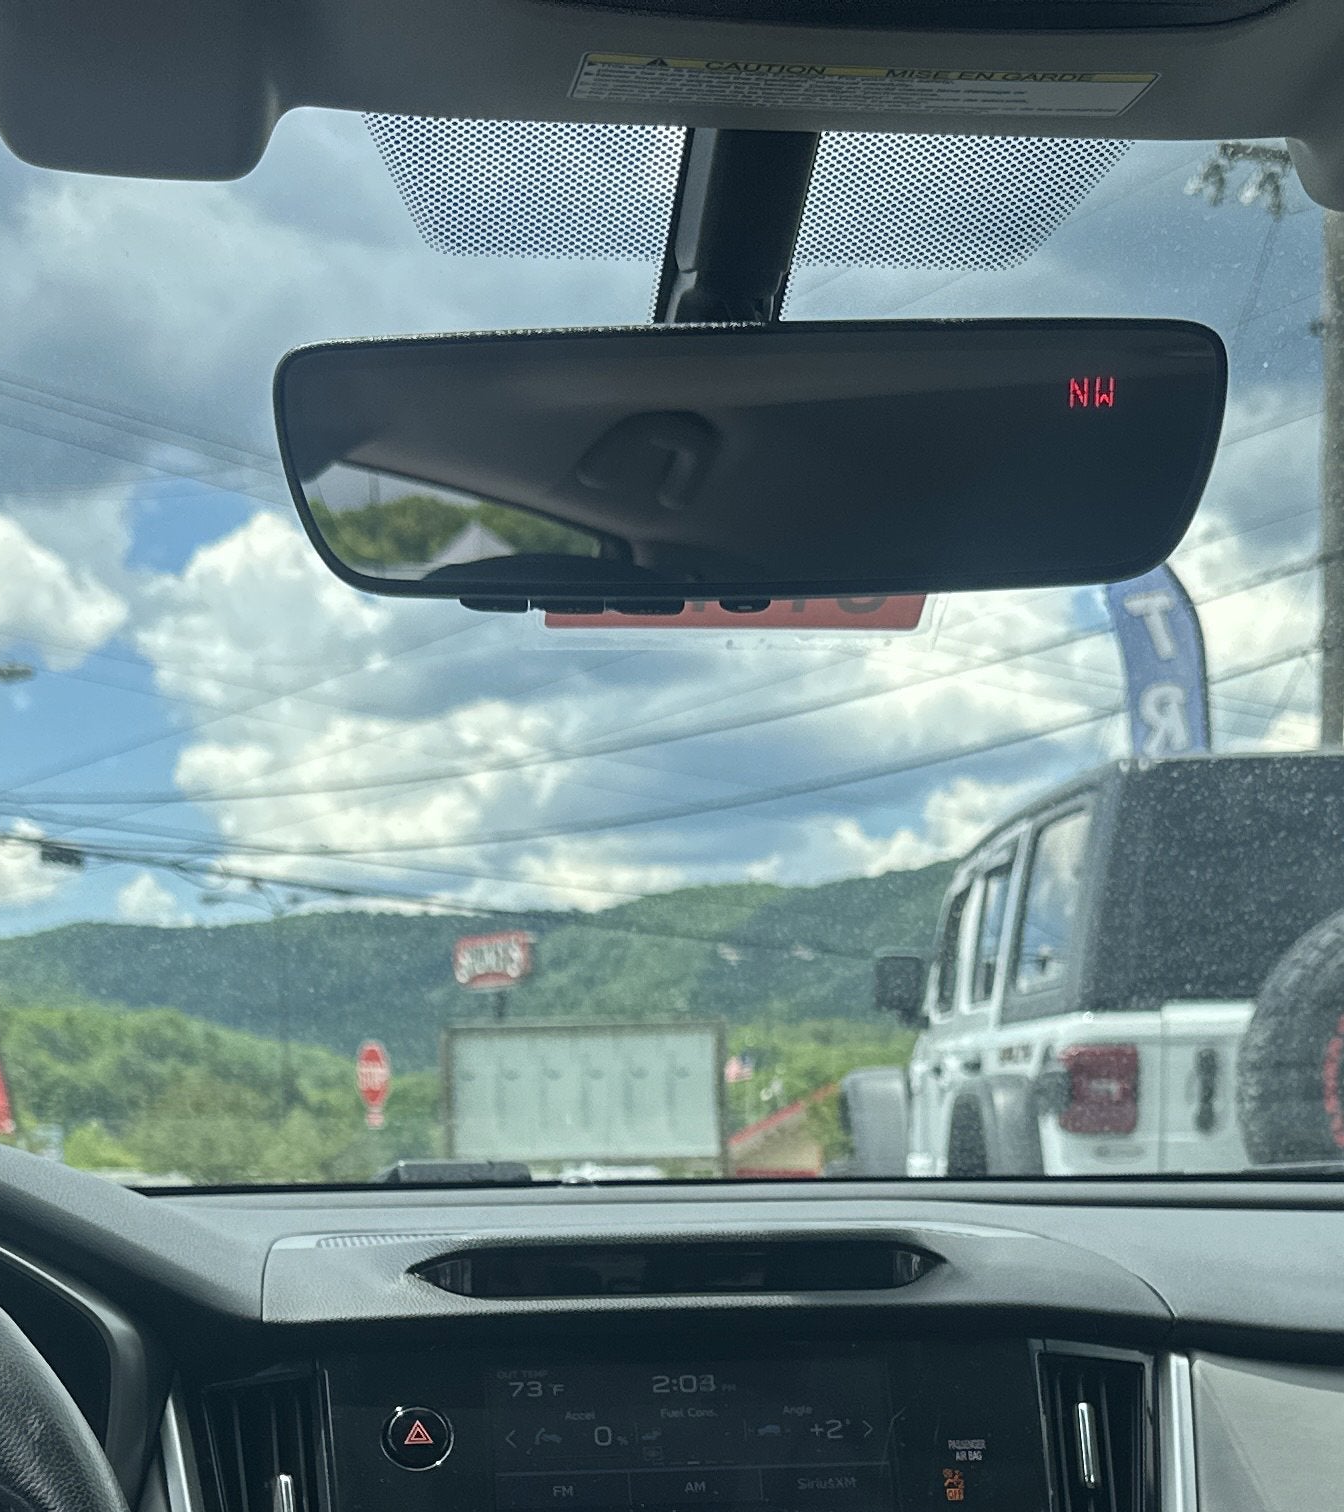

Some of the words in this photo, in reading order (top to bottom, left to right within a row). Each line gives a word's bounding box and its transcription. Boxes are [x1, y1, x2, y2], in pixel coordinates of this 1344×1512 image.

[705, 60, 827, 76] CAUTION
[886, 69, 948, 81] MISE
[957, 70, 998, 81] EN
[1002, 71, 1095, 83] GARDE
[1069, 376, 1114, 408] NW
[509, 1381, 542, 1397] 73
[565, 1411, 595, 1421] Accel
[660, 1407, 684, 1418] Fuel
[783, 1404, 813, 1417] Angle
[594, 1426, 612, 1446] 0
[684, 1481, 706, 1493] AM
[797, 1476, 857, 1490] SiriusXM
[553, 1485, 574, 1497] FM
